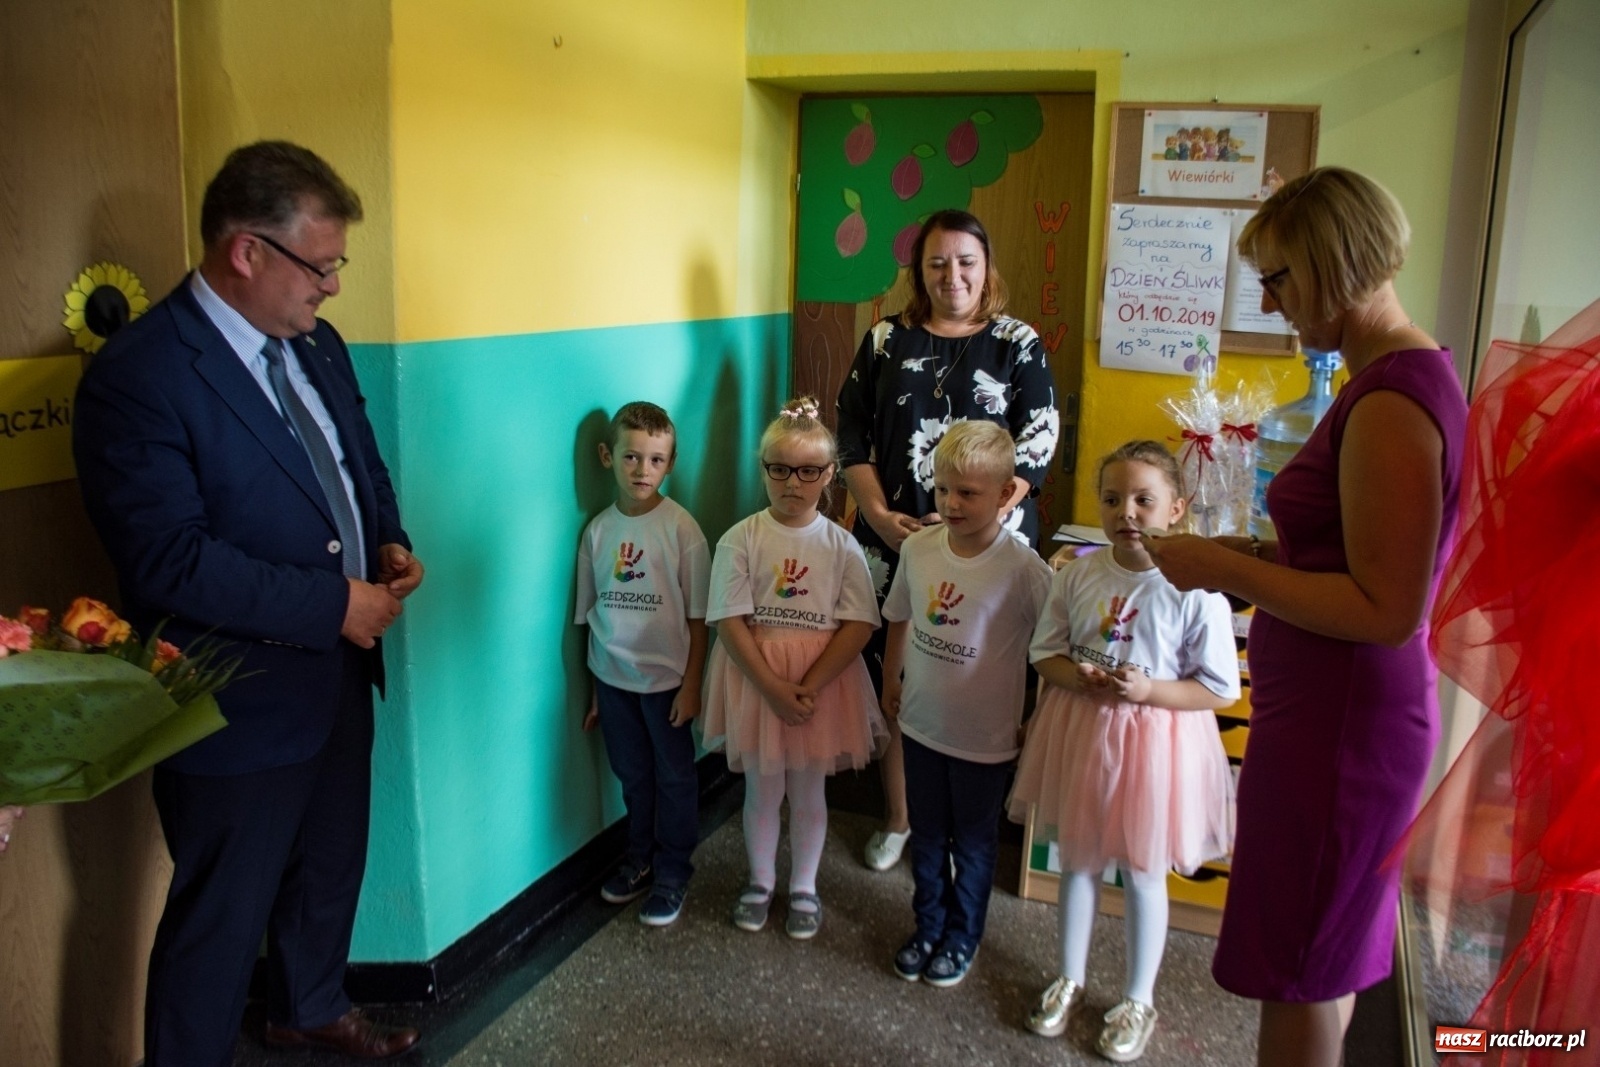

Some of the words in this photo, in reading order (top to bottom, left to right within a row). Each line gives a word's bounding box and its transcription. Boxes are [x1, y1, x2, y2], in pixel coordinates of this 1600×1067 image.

[1167, 168, 1235, 184] Wiewiórki
[1116, 206, 1214, 232] Serdecznie
[1121, 237, 1213, 263] zapraszamy
[1150, 254, 1170, 263] na
[1118, 303, 1216, 327] 01.10.2019
[1141, 326, 1195, 338] godzinach
